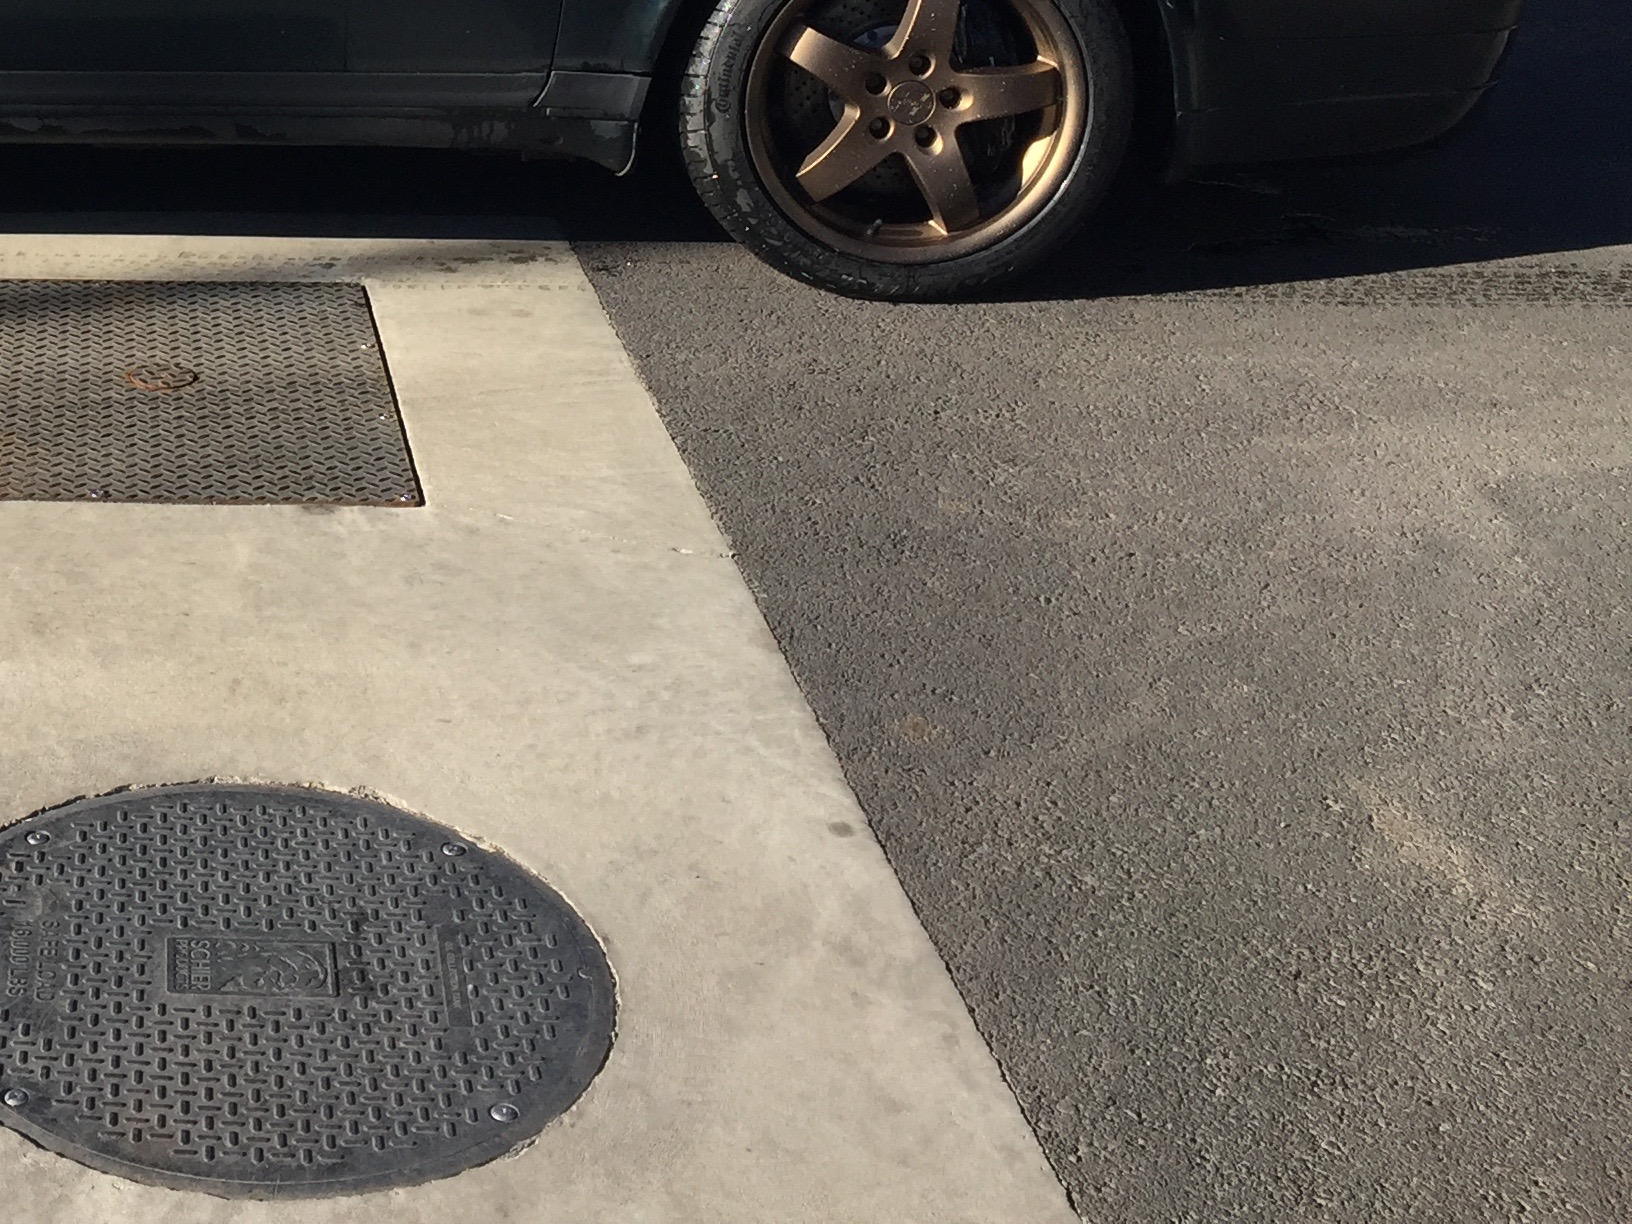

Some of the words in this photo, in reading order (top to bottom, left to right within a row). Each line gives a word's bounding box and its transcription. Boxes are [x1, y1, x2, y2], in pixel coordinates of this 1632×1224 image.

[37, 920, 61, 958] SAFE
[5, 967, 29, 998] LBS
[32, 960, 58, 1002] LOAD
[190, 939, 212, 991] SCHIER
